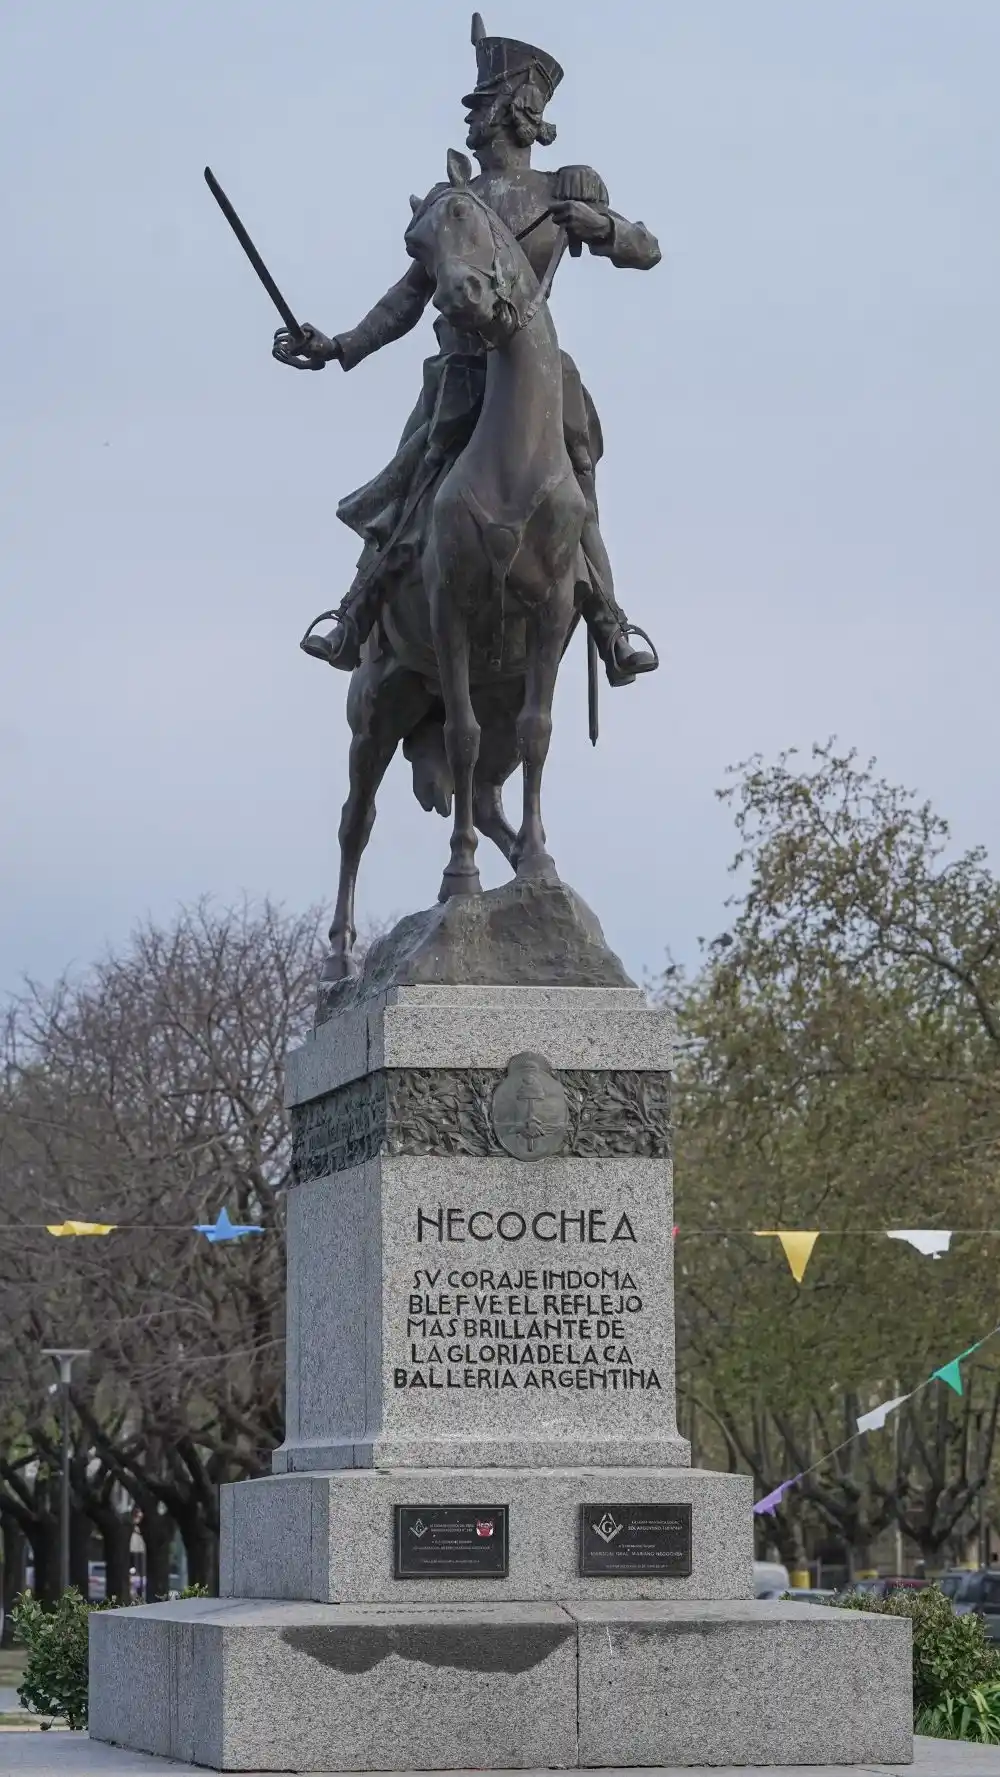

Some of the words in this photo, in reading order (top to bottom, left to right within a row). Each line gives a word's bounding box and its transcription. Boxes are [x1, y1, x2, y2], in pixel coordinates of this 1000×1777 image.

[417, 1208, 637, 1242] NECOCHEA
[413, 1269, 441, 1290] SV
[447, 1269, 538, 1290] CORAJE
[542, 1269, 637, 1290] INDOMA
[409, 1294, 450, 1316] BLE
[456, 1294, 502, 1316] FVE
[508, 1294, 537, 1316] EL
[543, 1294, 642, 1316] REFLEJO
[407, 1318, 457, 1339] MAS
[464, 1318, 591, 1339] BRILLANTE
[596, 1318, 624, 1339] DE
[411, 1343, 443, 1365] LA
[447, 1343, 533, 1365] GLORIA
[602, 1343, 633, 1365] CA
[394, 1368, 518, 1390] BALLERIA
[523, 1368, 661, 1390] ARGENTINA
